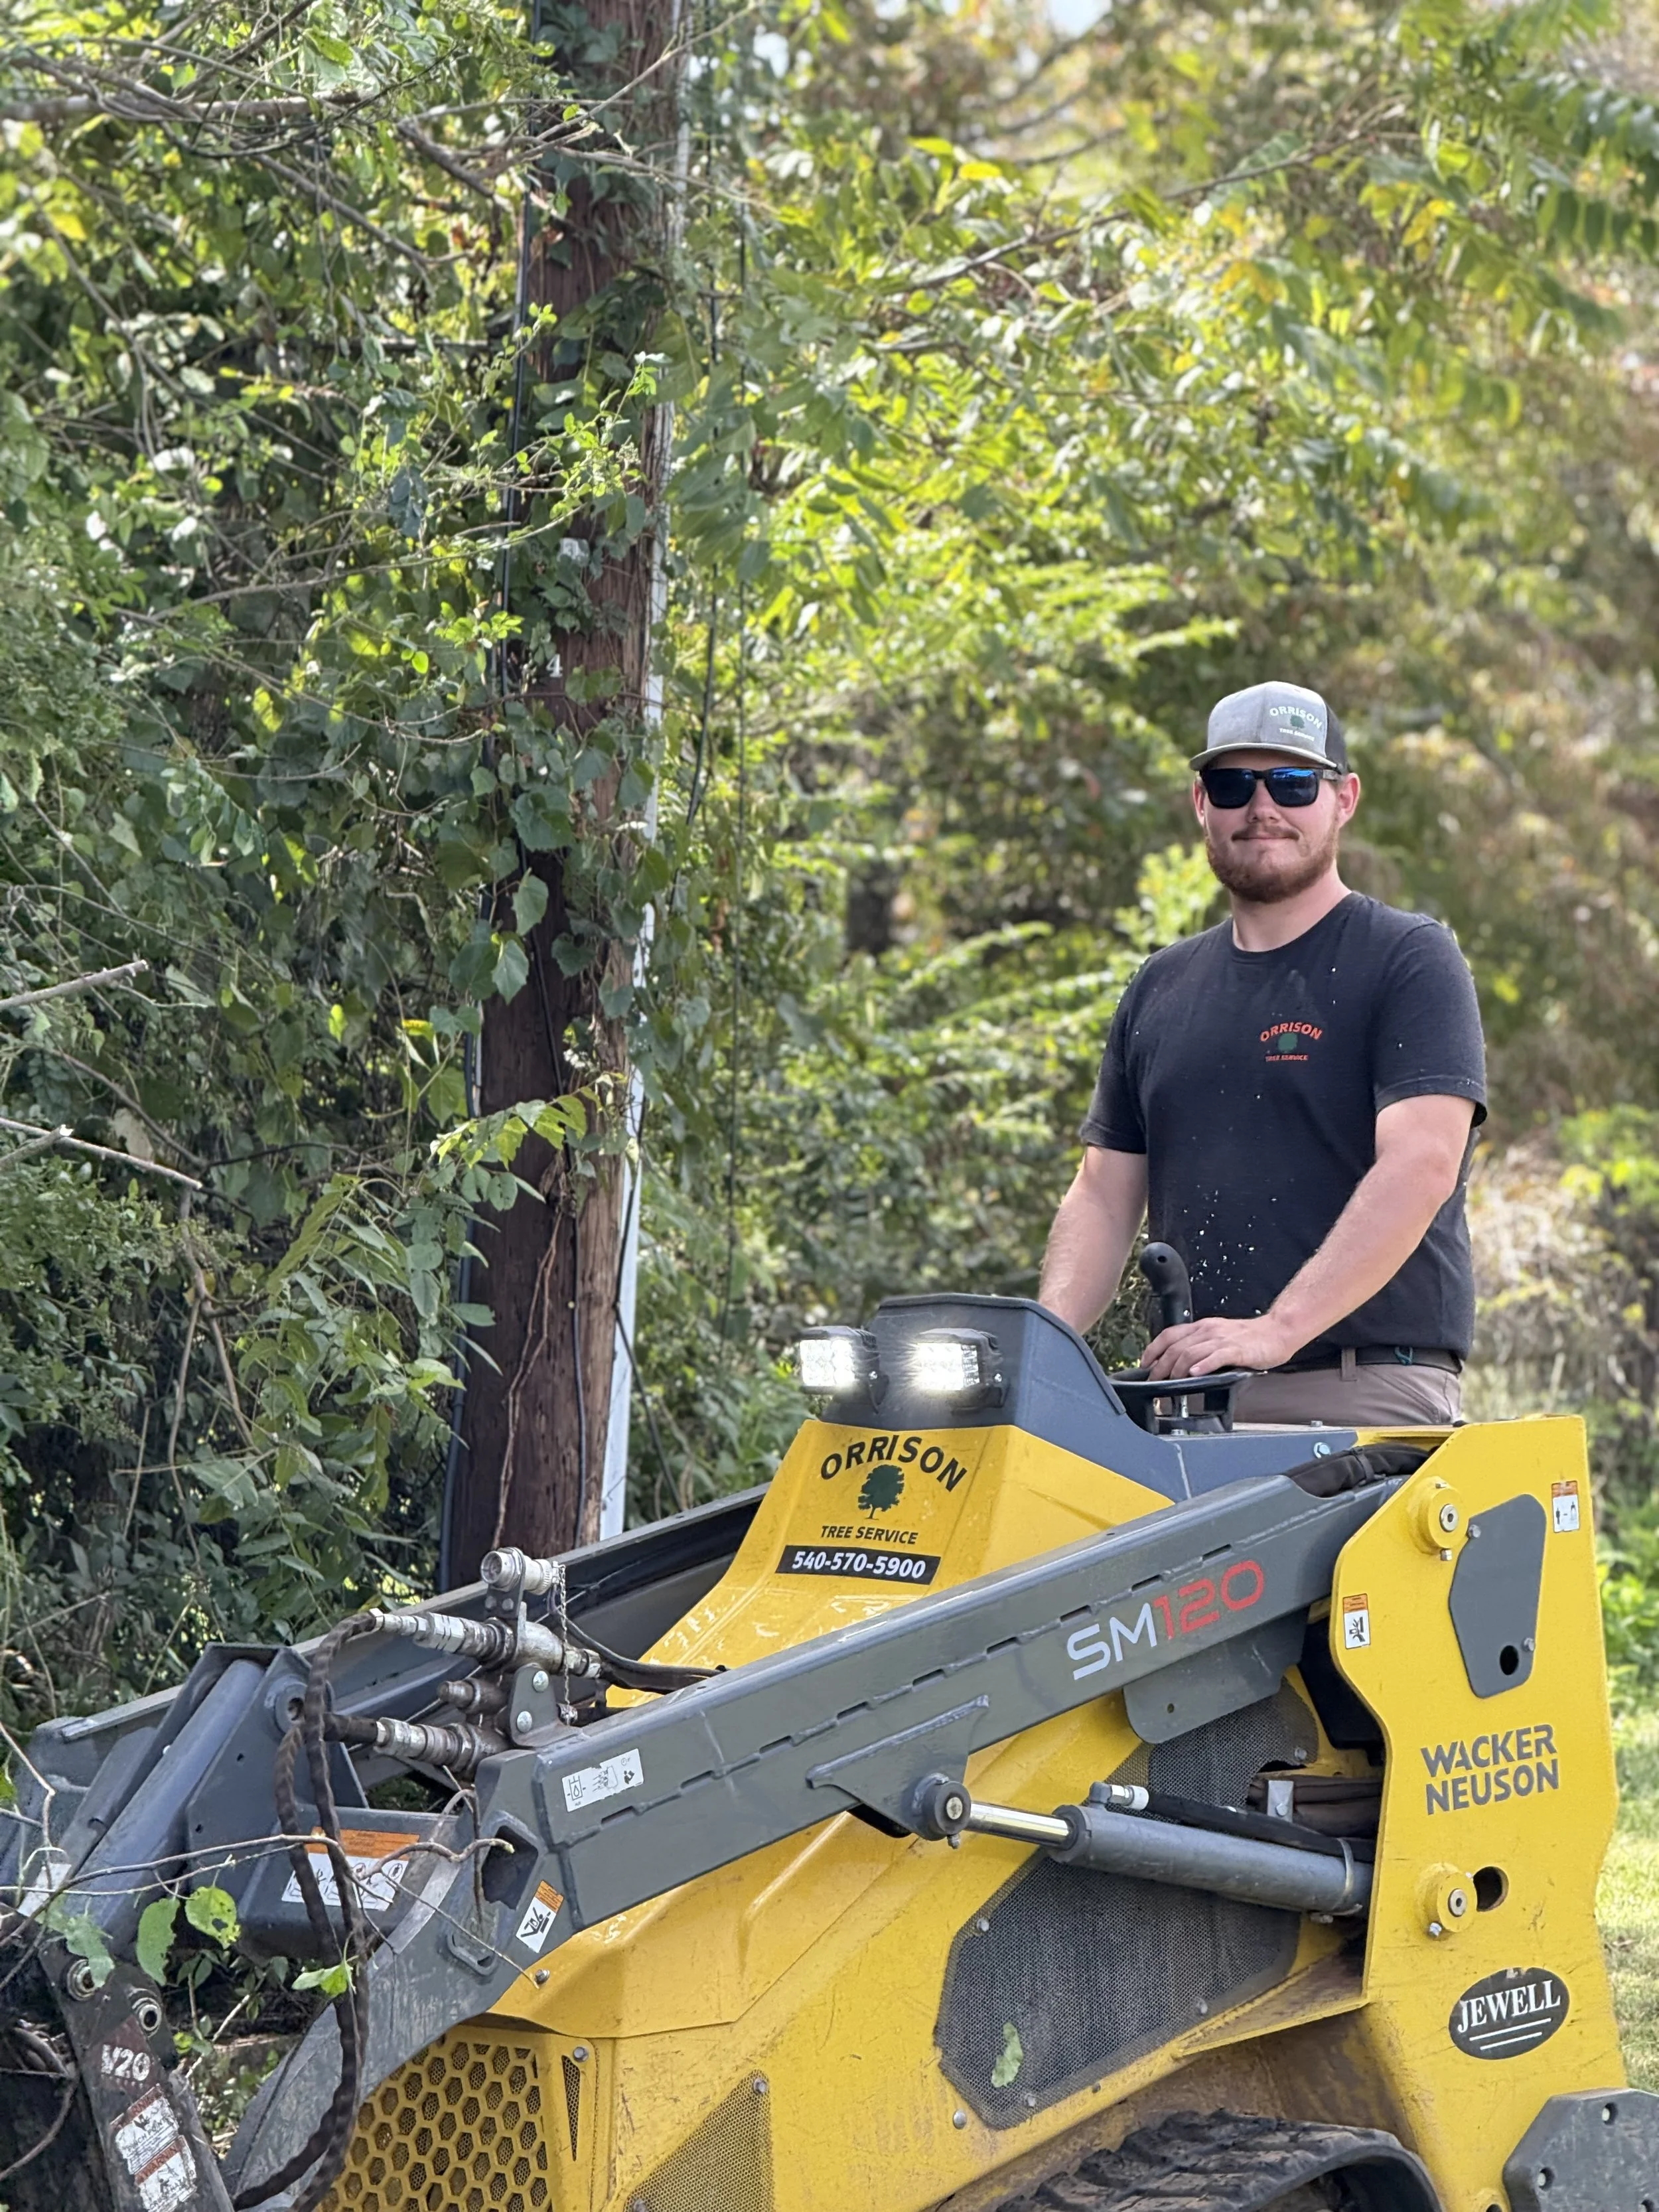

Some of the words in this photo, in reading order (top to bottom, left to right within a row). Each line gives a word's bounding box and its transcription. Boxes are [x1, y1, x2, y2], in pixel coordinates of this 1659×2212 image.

[546, 654, 563, 677] 4
[1269, 706, 1322, 729] ORRISON
[1260, 1022, 1322, 1041] ORRISON
[821, 1435, 968, 1492] ORRISON
[820, 1526, 853, 1538] TREE
[855, 1526, 918, 1544] SERVICE
[792, 1551, 926, 1579] 540-570-5900
[1067, 1560, 1265, 1680] SM120
[1420, 1724, 1557, 1778] WACKER
[1425, 1759, 1559, 1816] NEUSON
[1457, 1980, 1561, 2033] JEWELL
